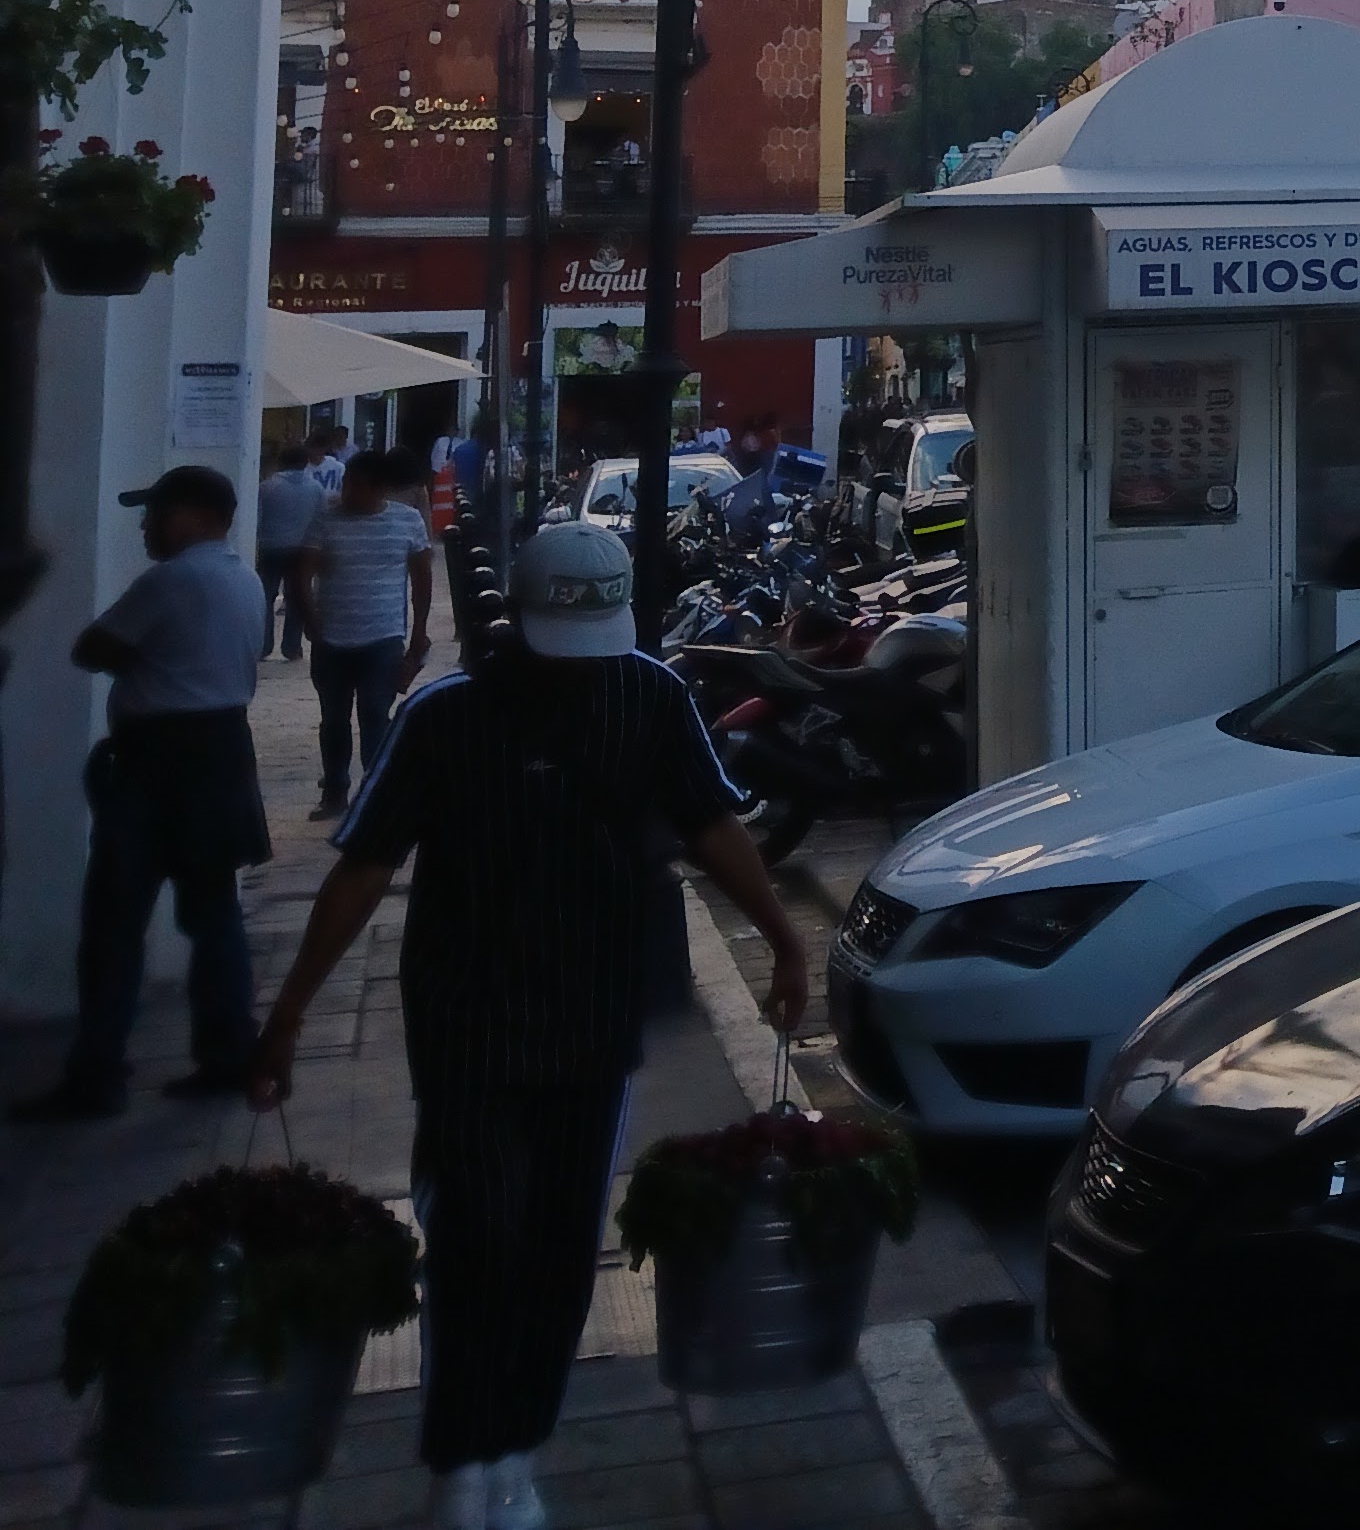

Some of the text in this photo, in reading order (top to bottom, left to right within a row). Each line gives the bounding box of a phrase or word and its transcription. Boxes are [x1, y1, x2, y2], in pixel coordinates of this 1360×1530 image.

[1118, 237, 1193, 253] AGUAS,
[1202, 233, 1317, 251] REFRESCOS
[1324, 233, 1336, 247] Y
[865, 246, 931, 263] Nestlé
[560, 261, 681, 298] Juquil
[843, 264, 953, 284] PurezaVital
[1140, 263, 1193, 297] EL
